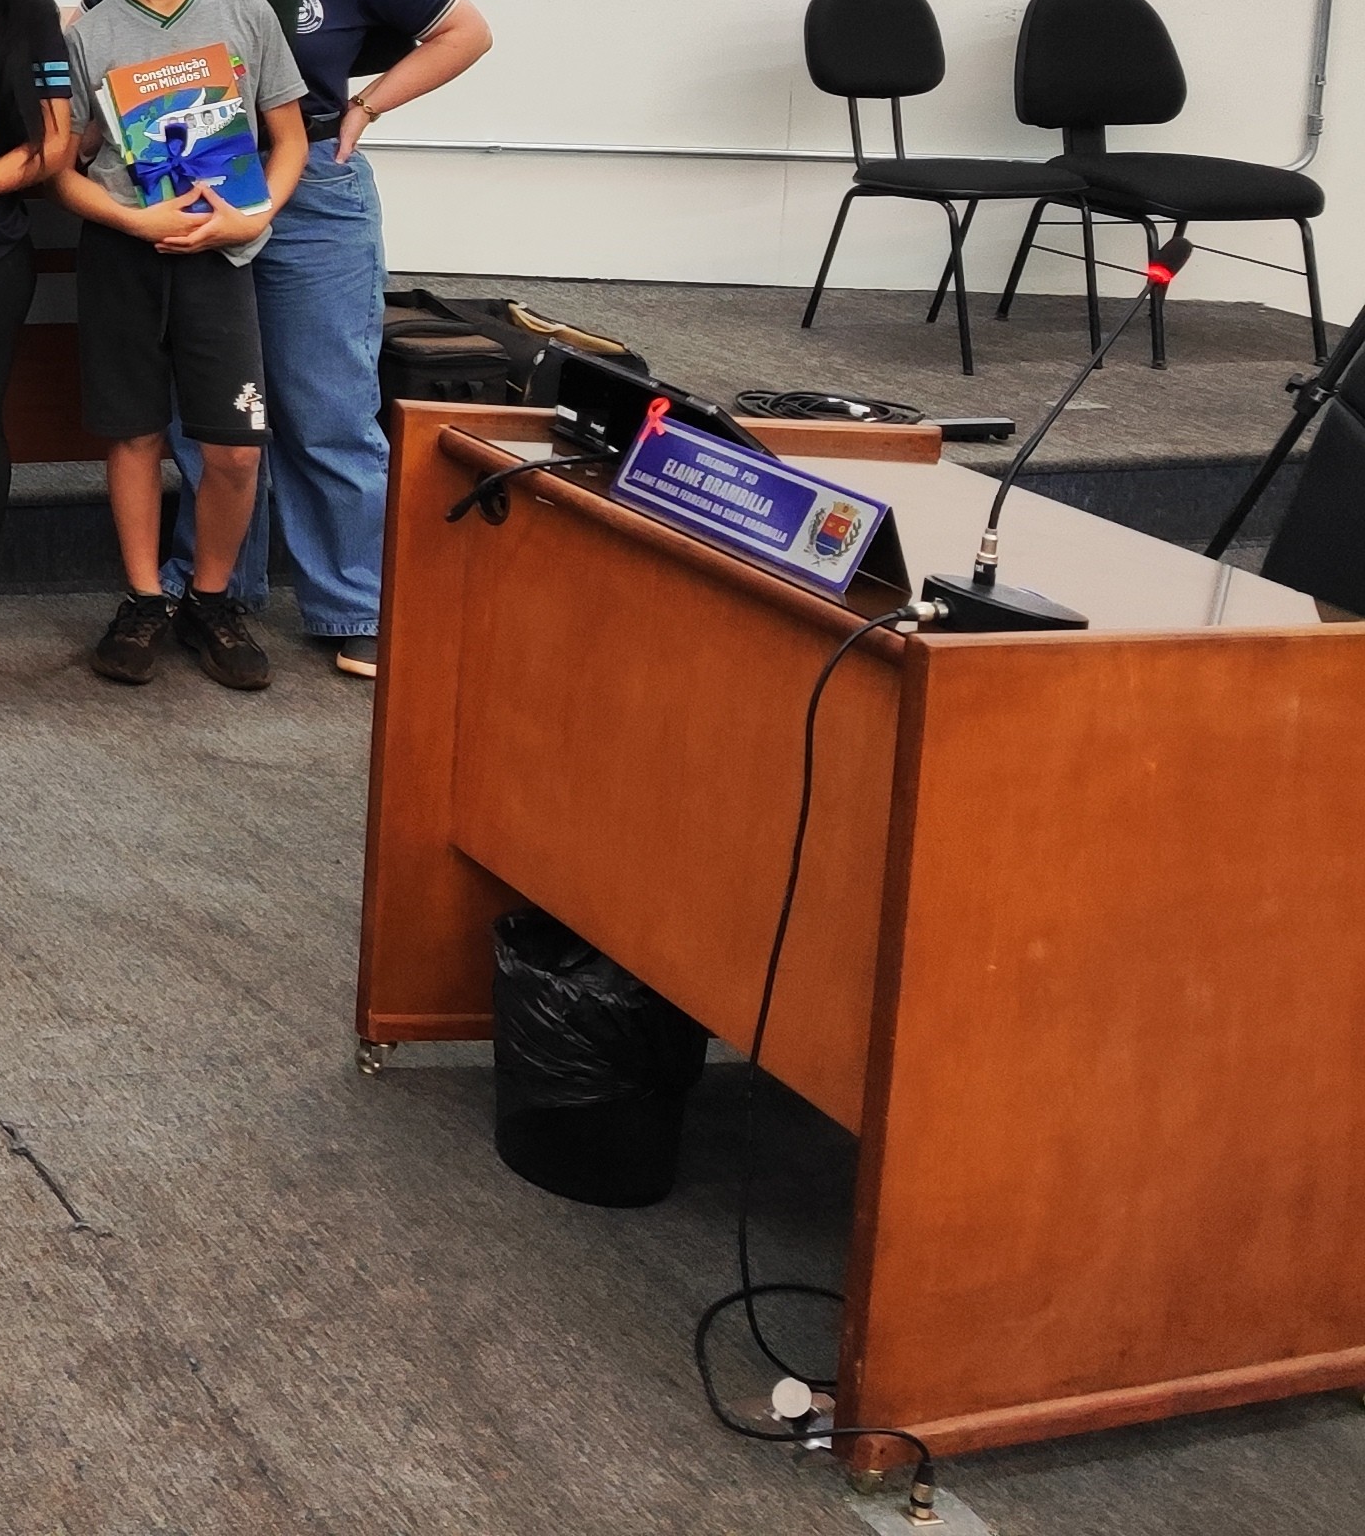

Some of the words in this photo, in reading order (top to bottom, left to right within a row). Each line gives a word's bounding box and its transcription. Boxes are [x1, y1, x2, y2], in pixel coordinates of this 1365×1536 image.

[133, 57, 207, 85] Constituição
[139, 83, 159, 94] em
[159, 72, 201, 89] Miúdos
[202, 67, 210, 79] II
[661, 457, 705, 488] ELAINE
[700, 474, 773, 517] BRAMBILLA
